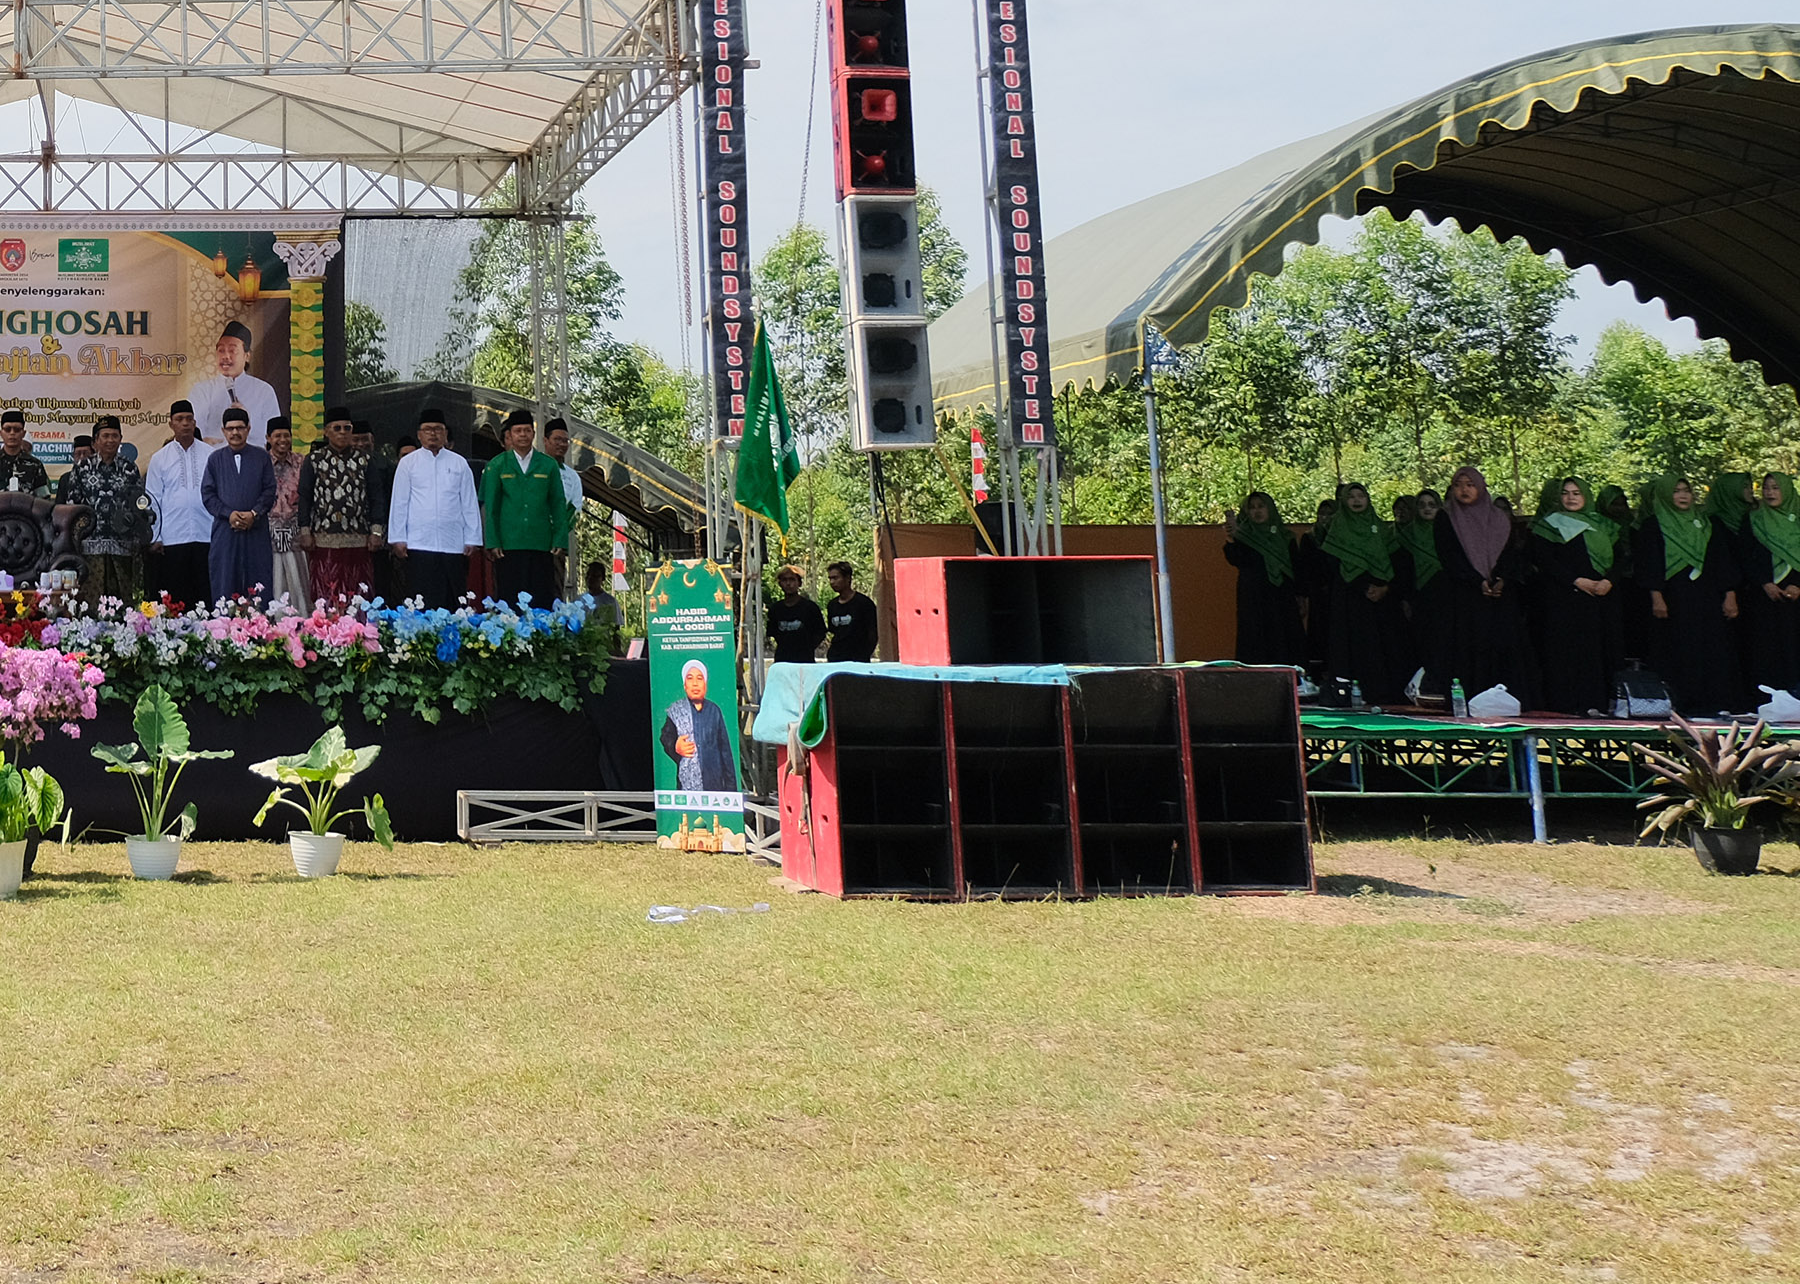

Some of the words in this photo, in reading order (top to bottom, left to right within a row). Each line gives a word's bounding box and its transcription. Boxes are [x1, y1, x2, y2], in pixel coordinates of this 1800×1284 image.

[40, 334, 62, 355] &
[78, 343, 187, 377] Akbar
[675, 608, 708, 616] HABIB
[651, 614, 731, 624] ABDURRAHMAN
[669, 623, 684, 631] AL
[684, 622, 715, 631] QODRI
